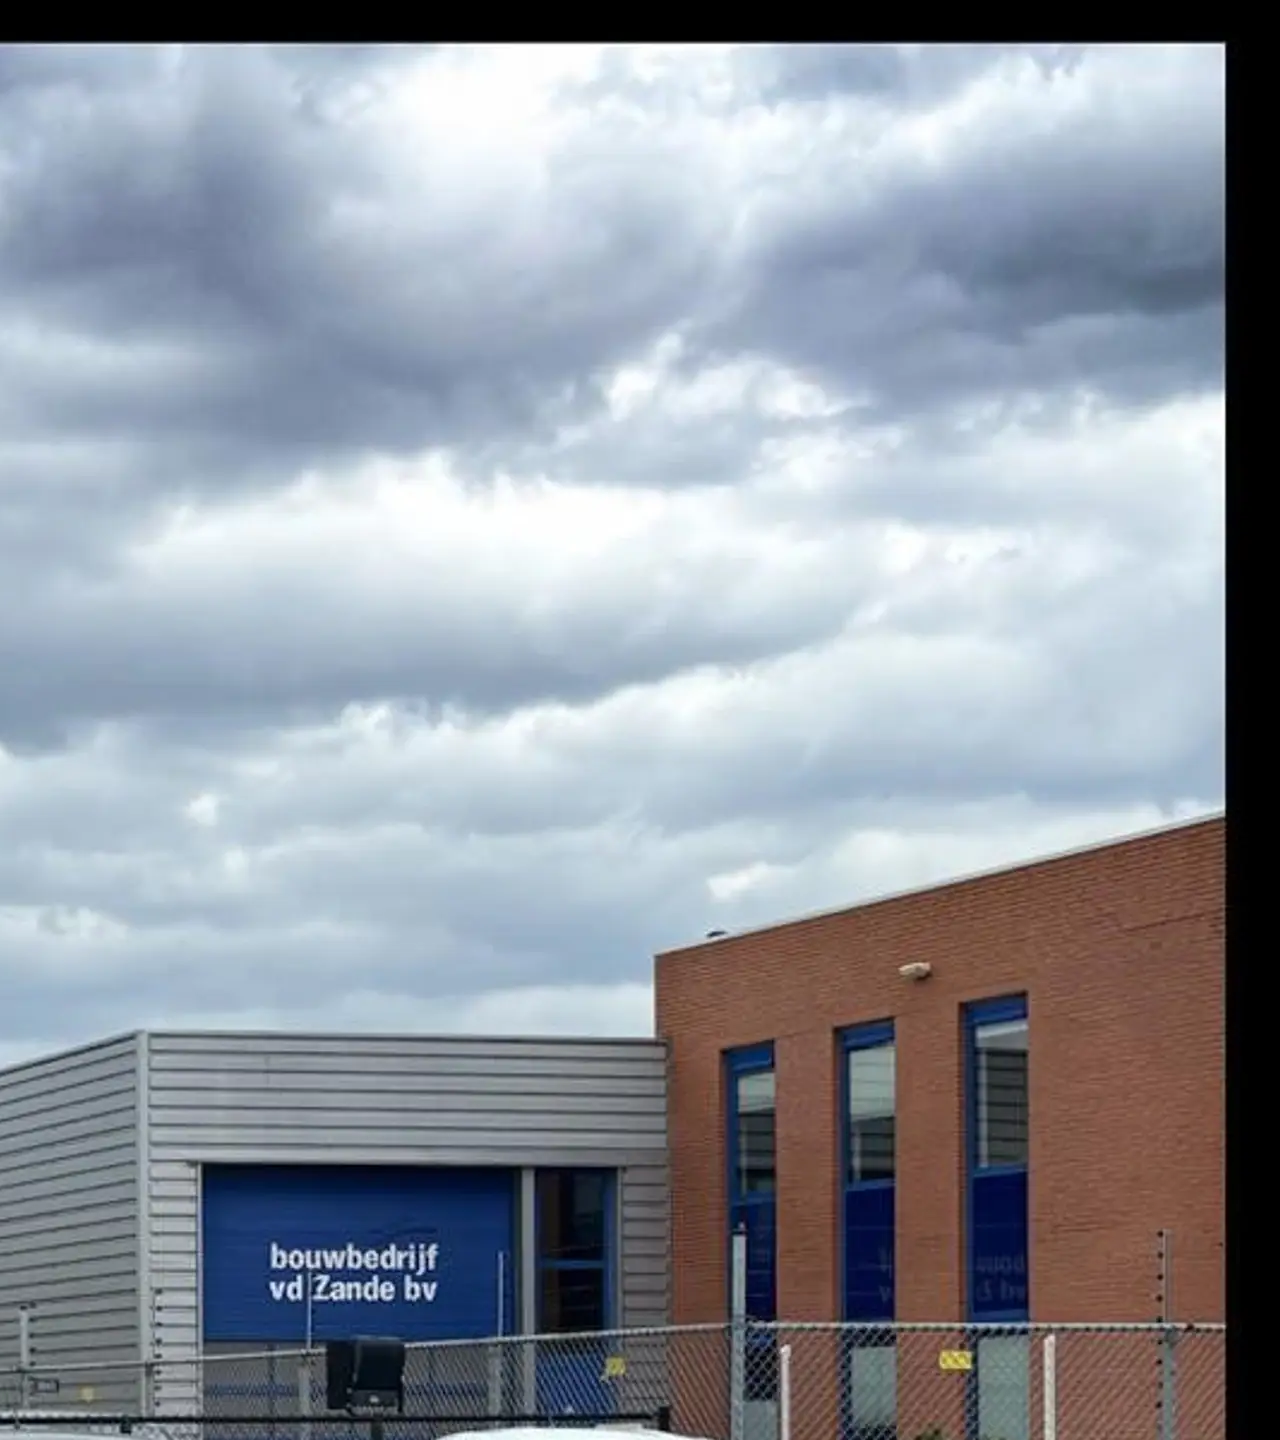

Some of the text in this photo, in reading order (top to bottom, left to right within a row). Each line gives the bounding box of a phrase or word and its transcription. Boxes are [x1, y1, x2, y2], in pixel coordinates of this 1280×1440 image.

[270, 1242, 439, 1276] bouwbedrijf
[269, 1274, 438, 1302] vd Zande bv
